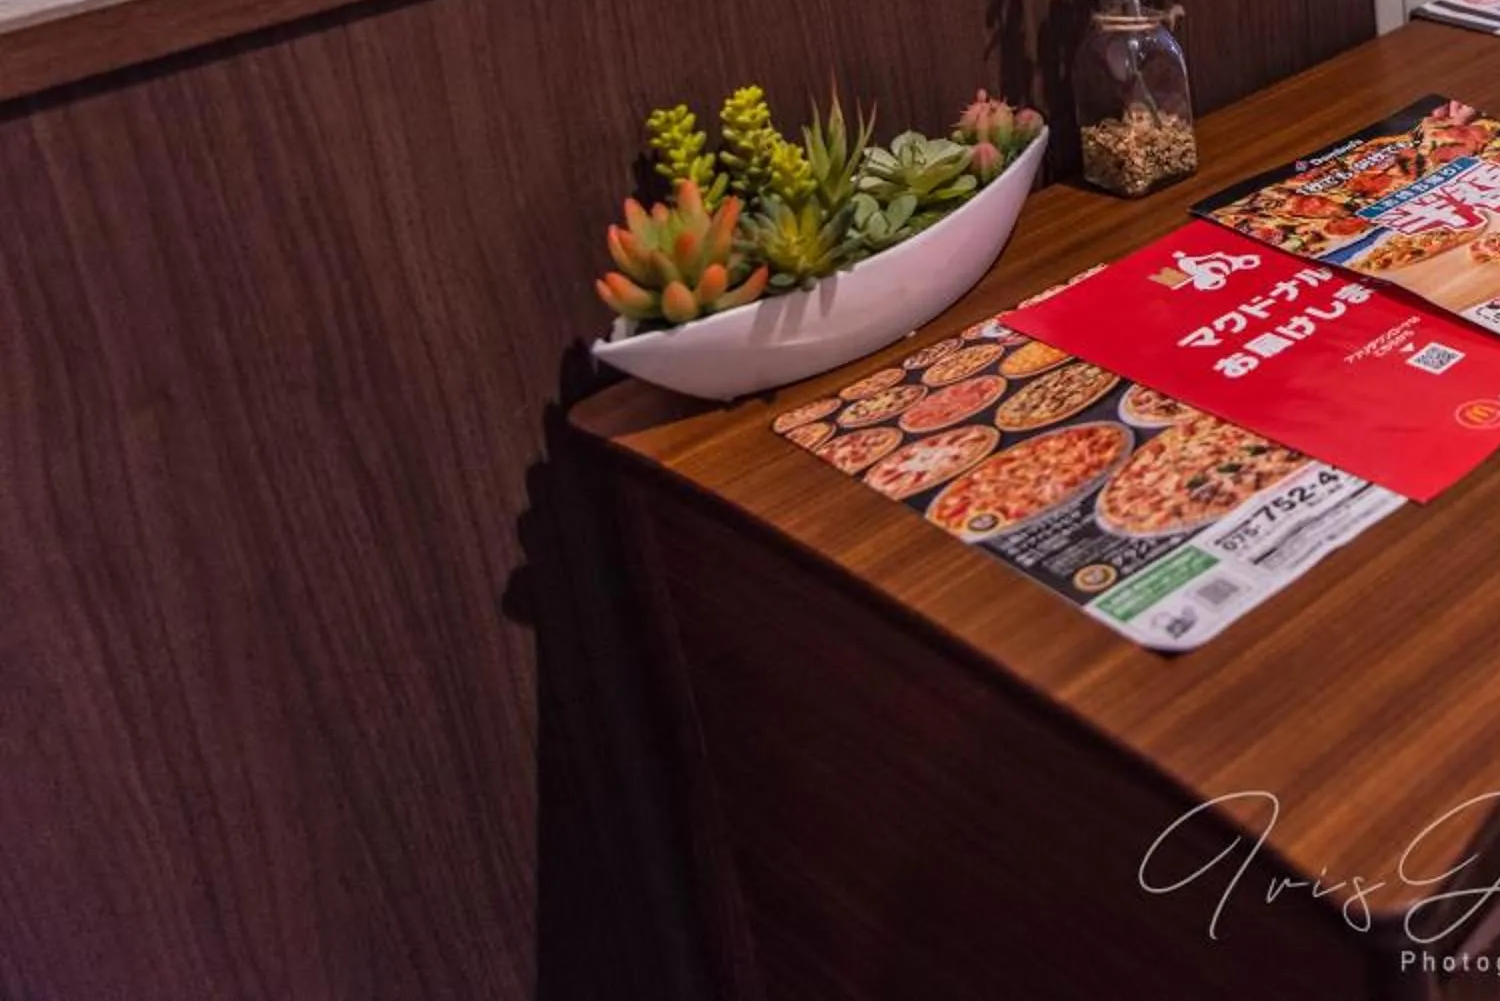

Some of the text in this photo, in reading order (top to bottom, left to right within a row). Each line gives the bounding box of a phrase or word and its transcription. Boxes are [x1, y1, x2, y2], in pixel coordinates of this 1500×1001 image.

[1177, 266, 1334, 347] マクドナル
[1222, 465, 1342, 551] 075-752-4
